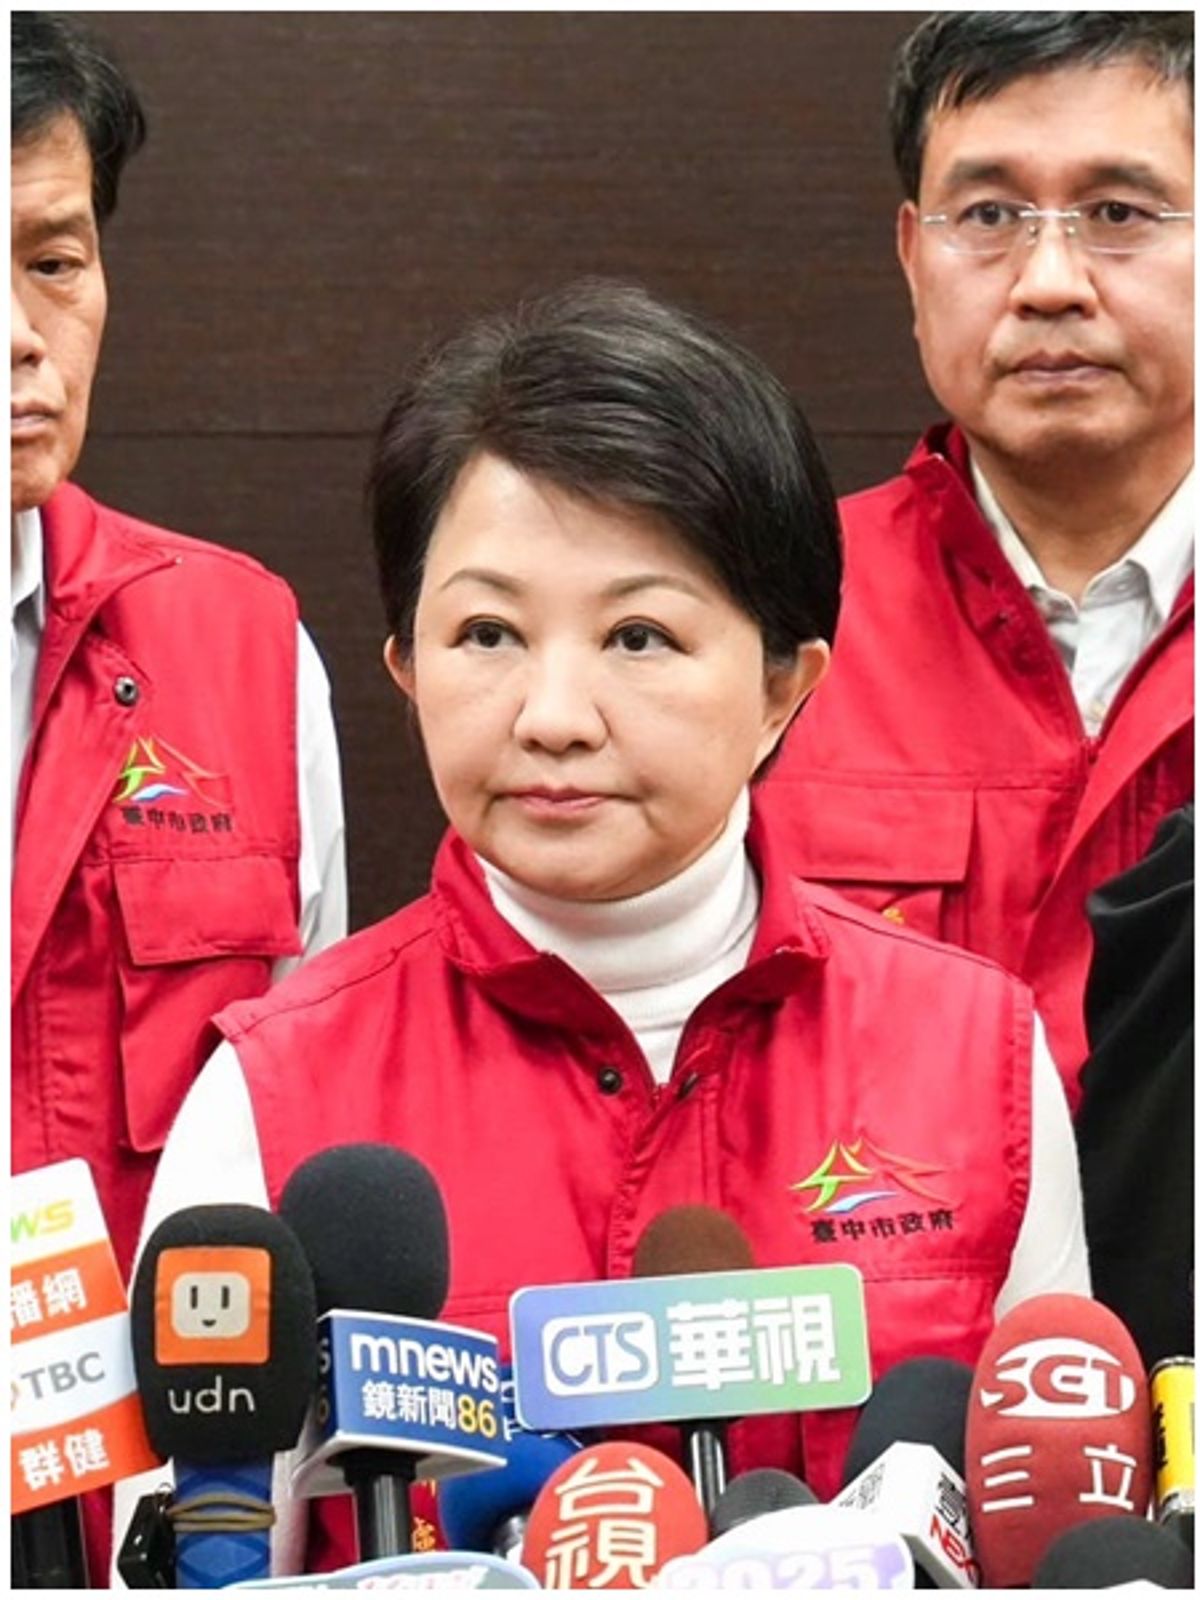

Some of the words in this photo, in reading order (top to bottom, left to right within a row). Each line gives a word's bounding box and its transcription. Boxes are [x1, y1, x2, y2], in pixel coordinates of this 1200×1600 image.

[810, 1207, 953, 1244] 臺中市政府
[350, 1332, 500, 1394] mnews
[549, 1321, 650, 1387] CTS
[666, 1293, 842, 1391] 華視
[19, 1350, 106, 1400] TBC
[169, 1376, 256, 1414] udn
[18, 1427, 111, 1492] 群健
[981, 1443, 1138, 1512] 三立
[545, 1457, 665, 1590] 台視
